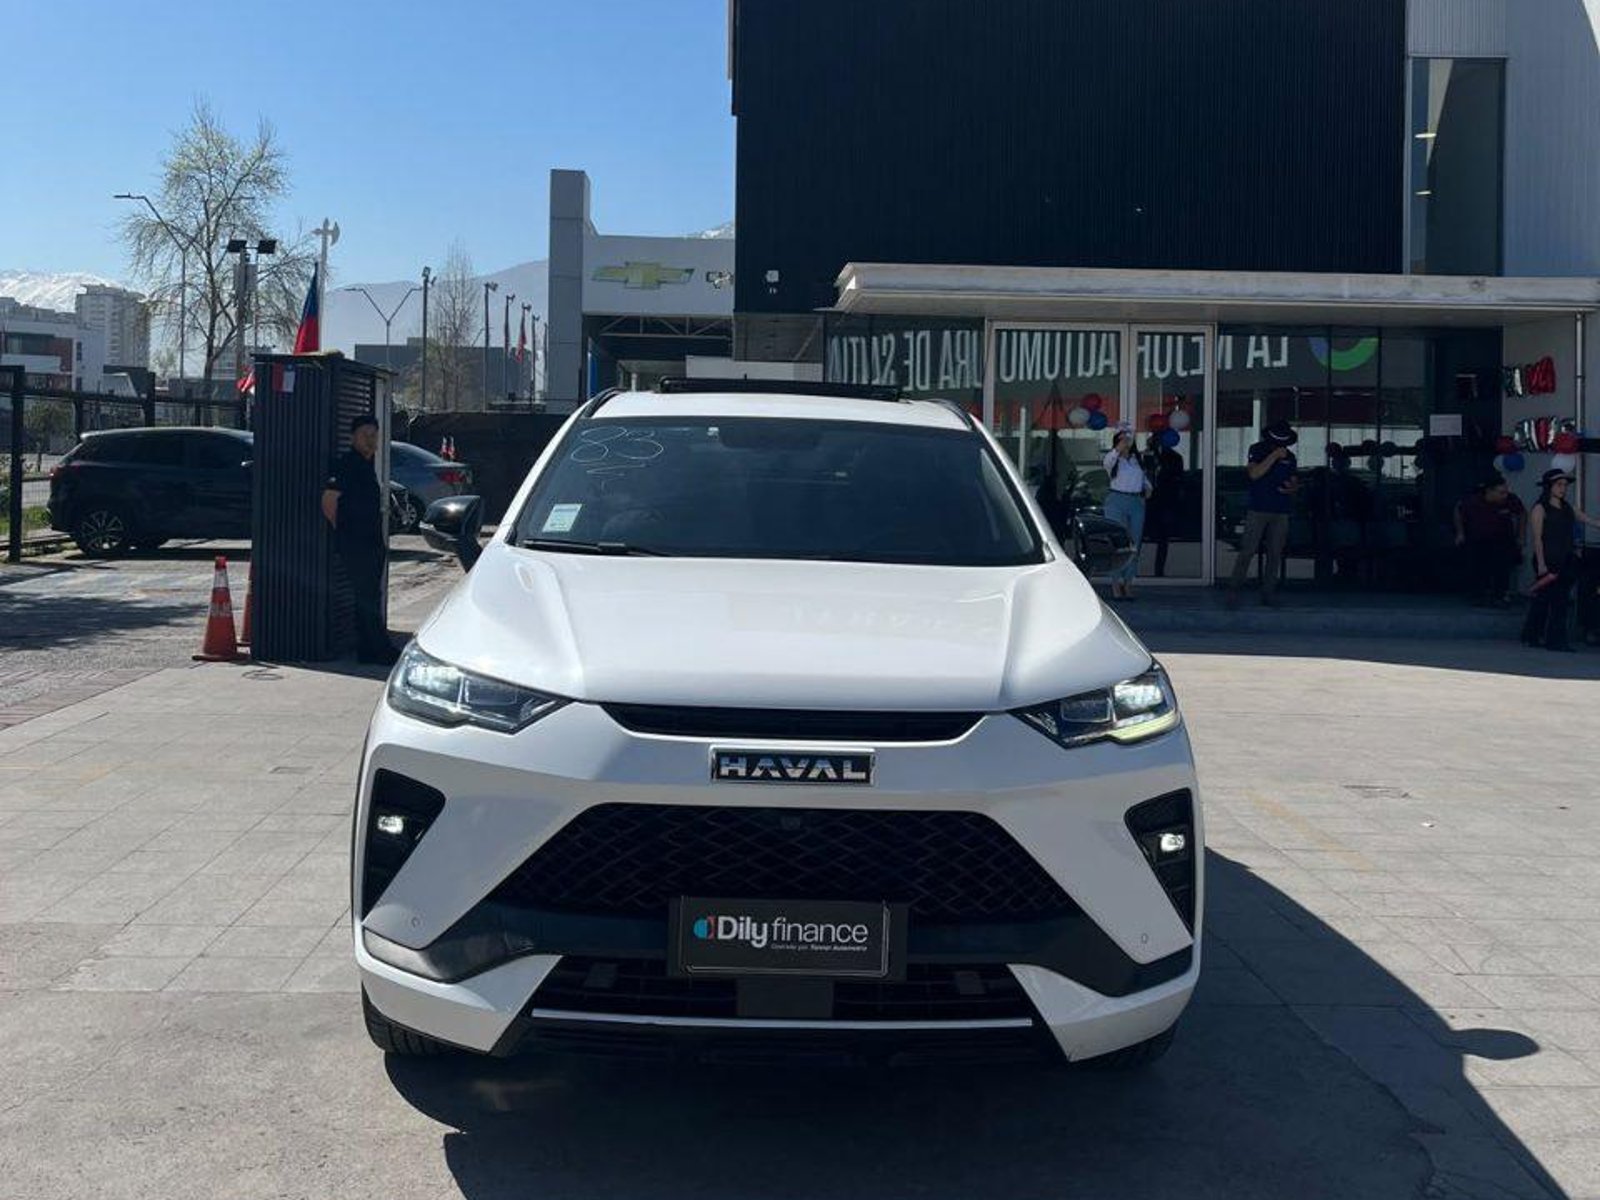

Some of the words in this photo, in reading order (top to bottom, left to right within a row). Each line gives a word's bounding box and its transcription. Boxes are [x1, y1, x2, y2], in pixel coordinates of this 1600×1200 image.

[719, 756, 867, 780] HAVAL
[717, 915, 769, 949] Dily
[771, 917, 868, 943] finance
